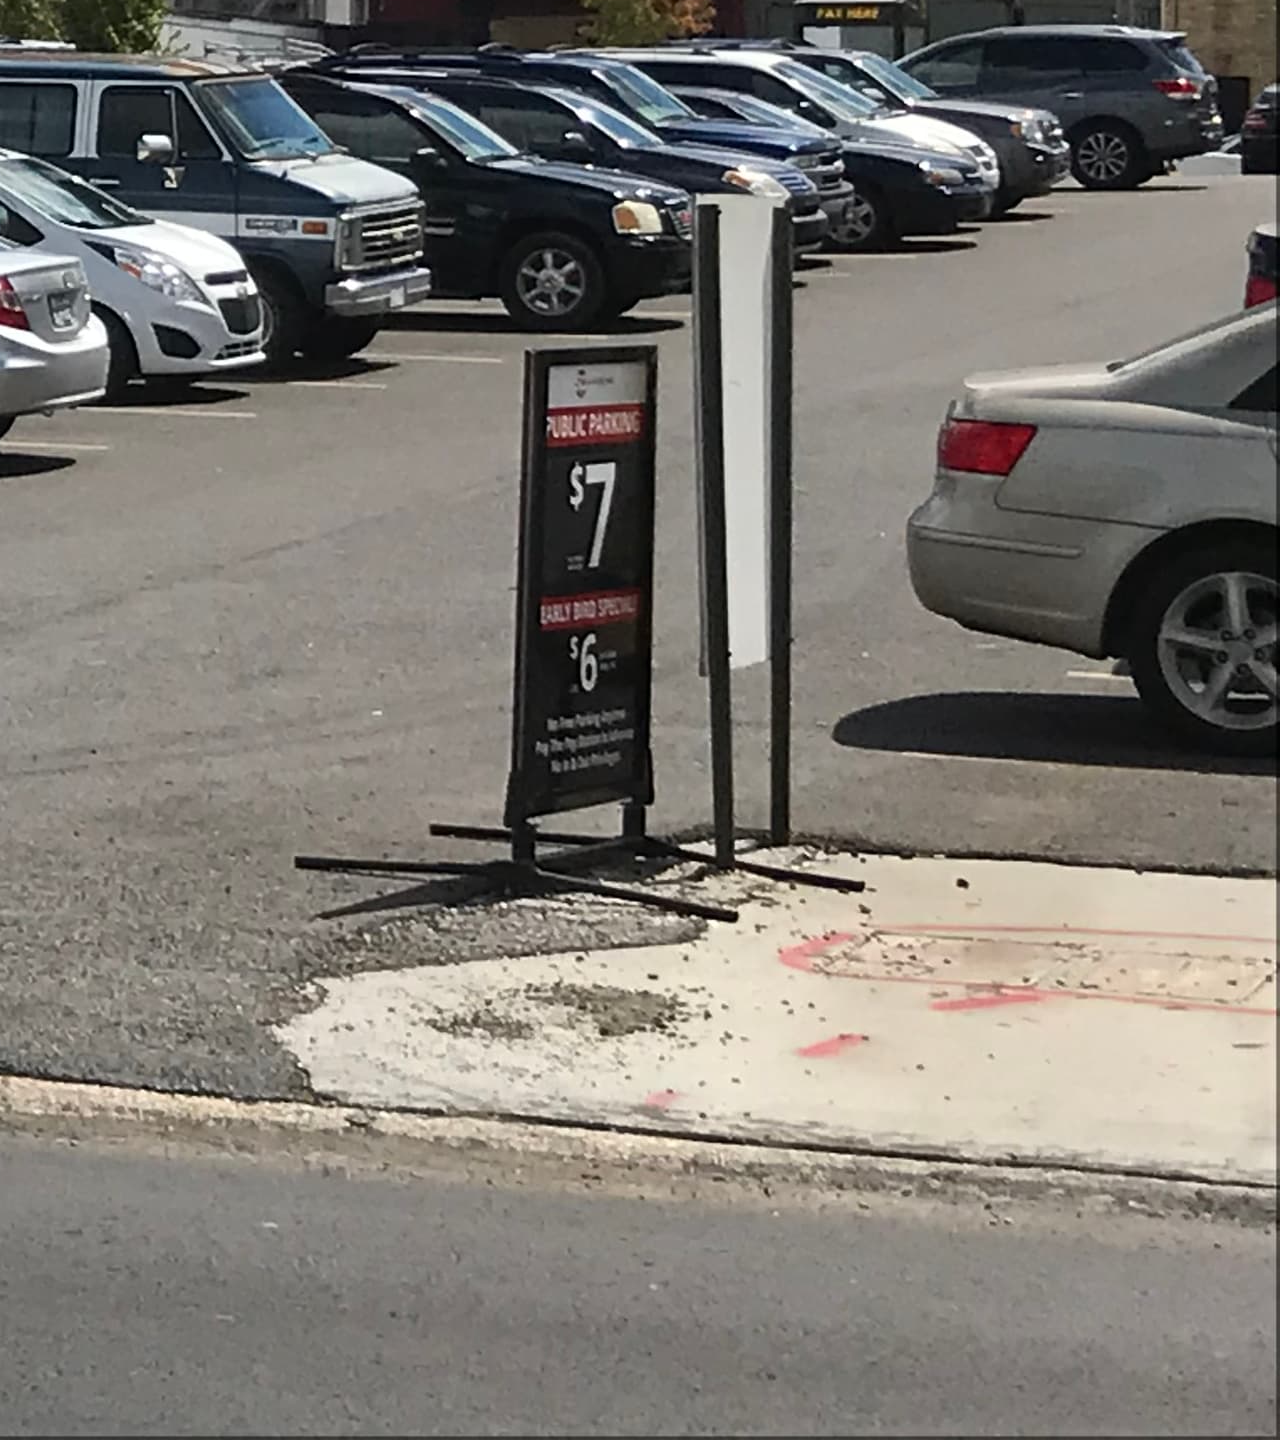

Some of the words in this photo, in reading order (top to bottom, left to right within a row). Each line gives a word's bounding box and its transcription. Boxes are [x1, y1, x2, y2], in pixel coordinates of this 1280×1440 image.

[589, 412, 641, 436] PARKING
[569, 461, 616, 568] $7
[569, 633, 598, 692] $6
